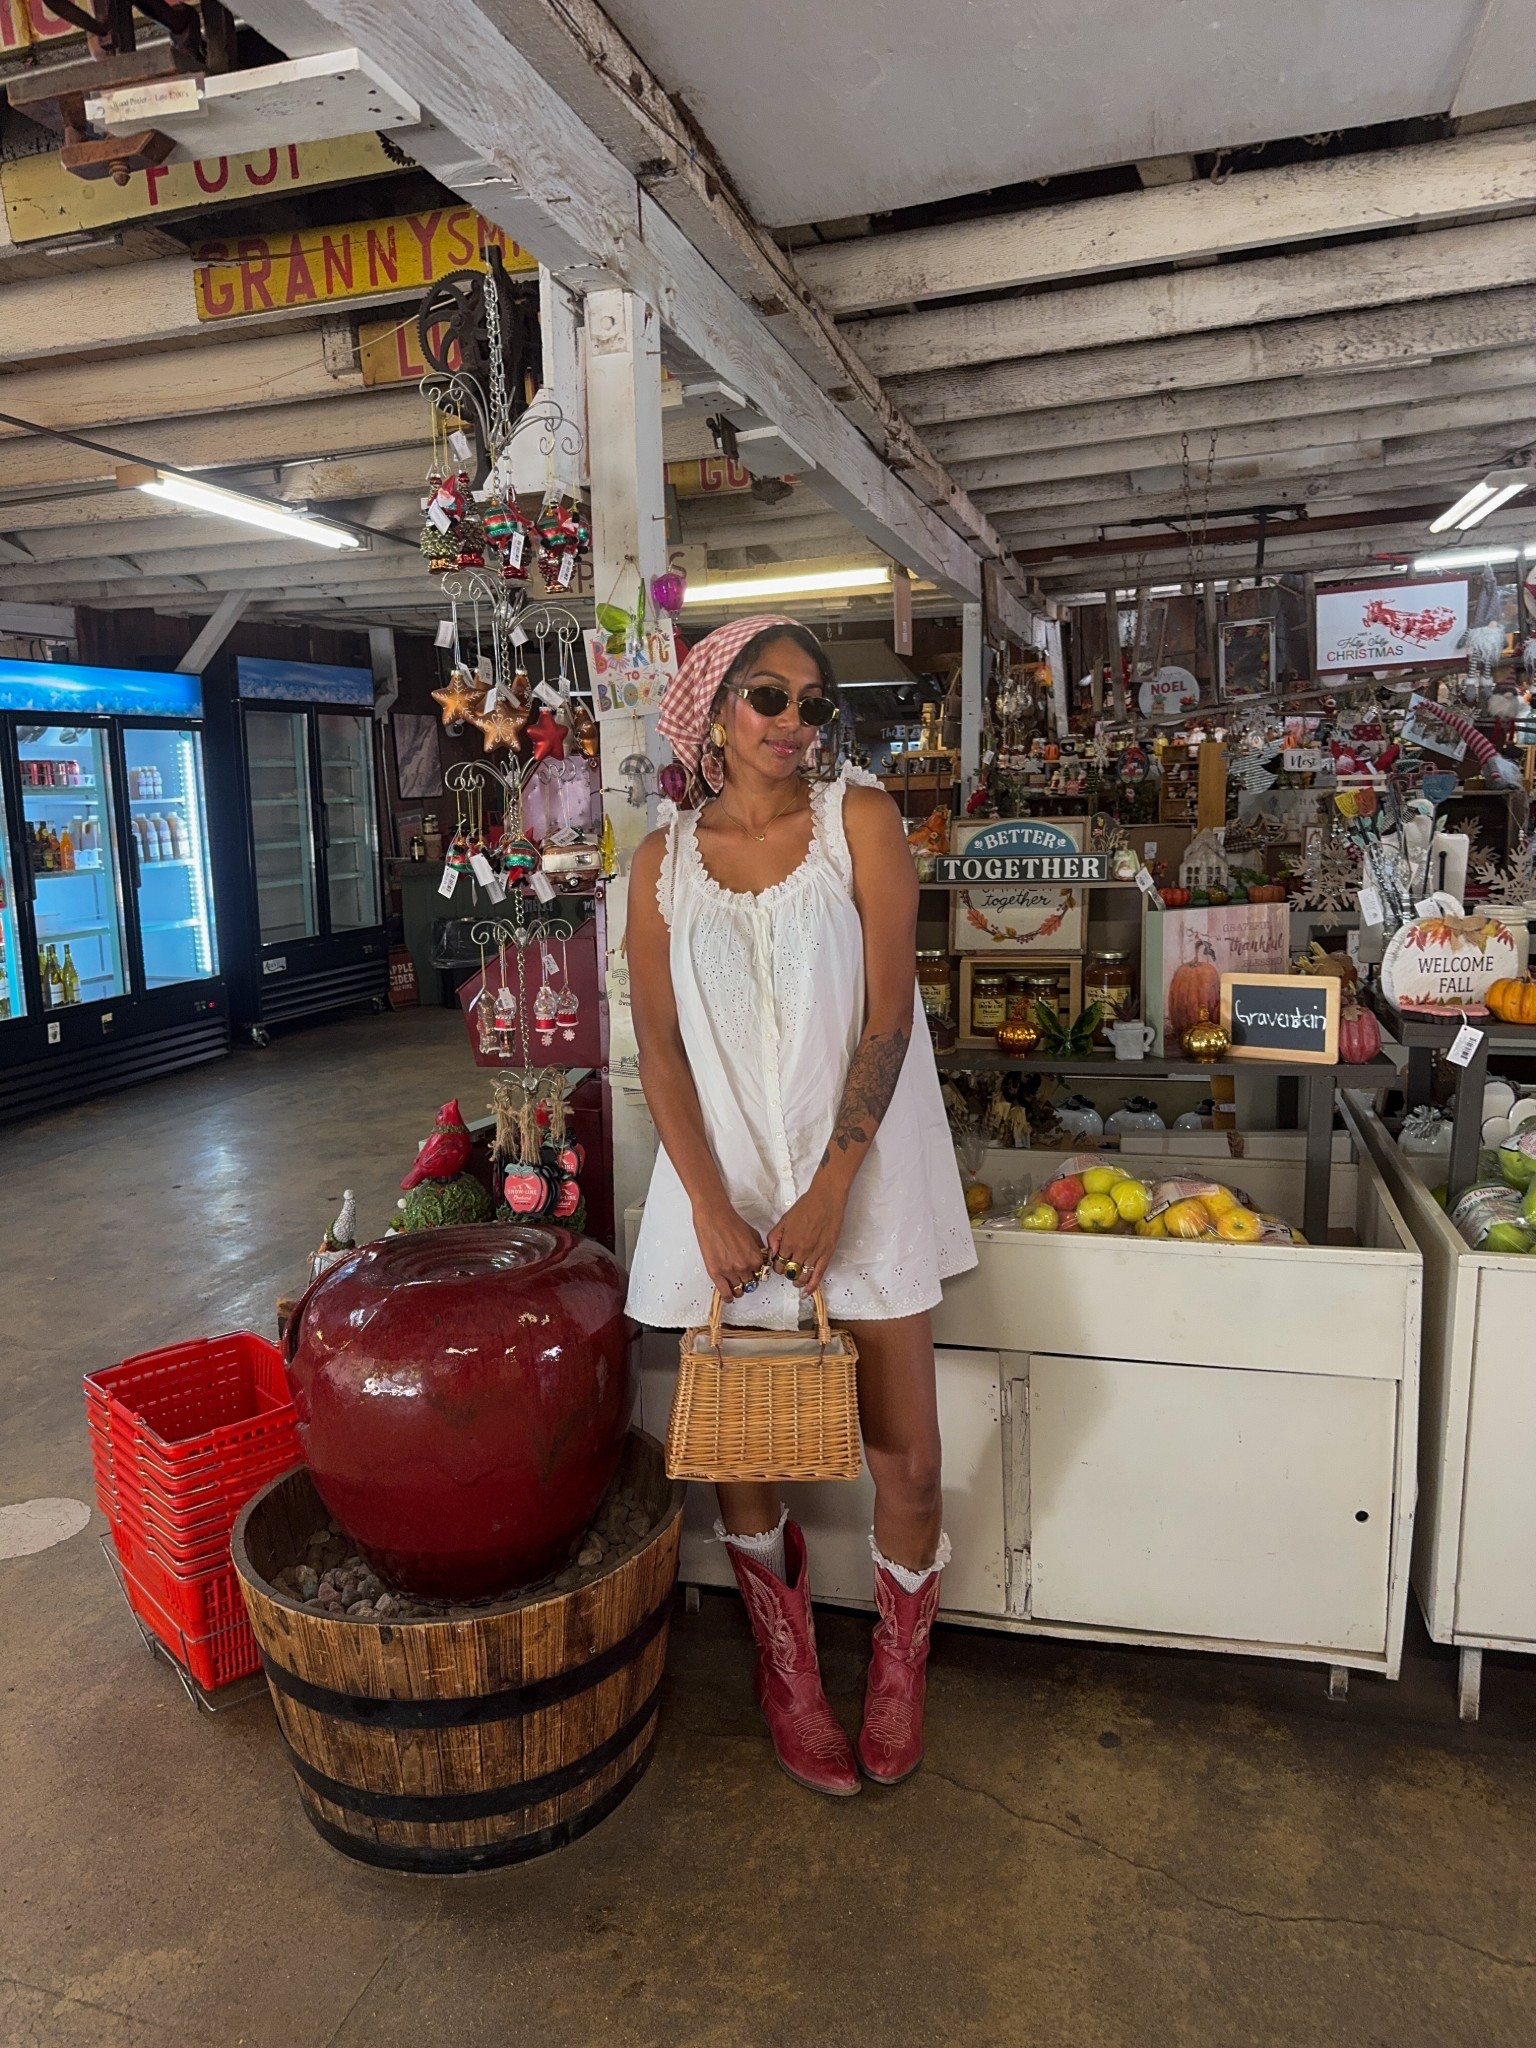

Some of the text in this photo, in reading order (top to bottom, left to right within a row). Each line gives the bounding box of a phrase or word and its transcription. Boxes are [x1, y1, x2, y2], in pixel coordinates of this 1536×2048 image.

[199, 211, 442, 316] GRANNY
[1326, 645, 1404, 662] CHRISTMAS
[625, 670, 640, 681] TO
[1151, 681, 1188, 695] NOEL
[983, 828, 1057, 850] BETTER
[943, 857, 1100, 880] TOGETHER
[981, 890, 1051, 913] together
[1418, 956, 1494, 974] WELCOME
[1439, 977, 1474, 993] FALL
